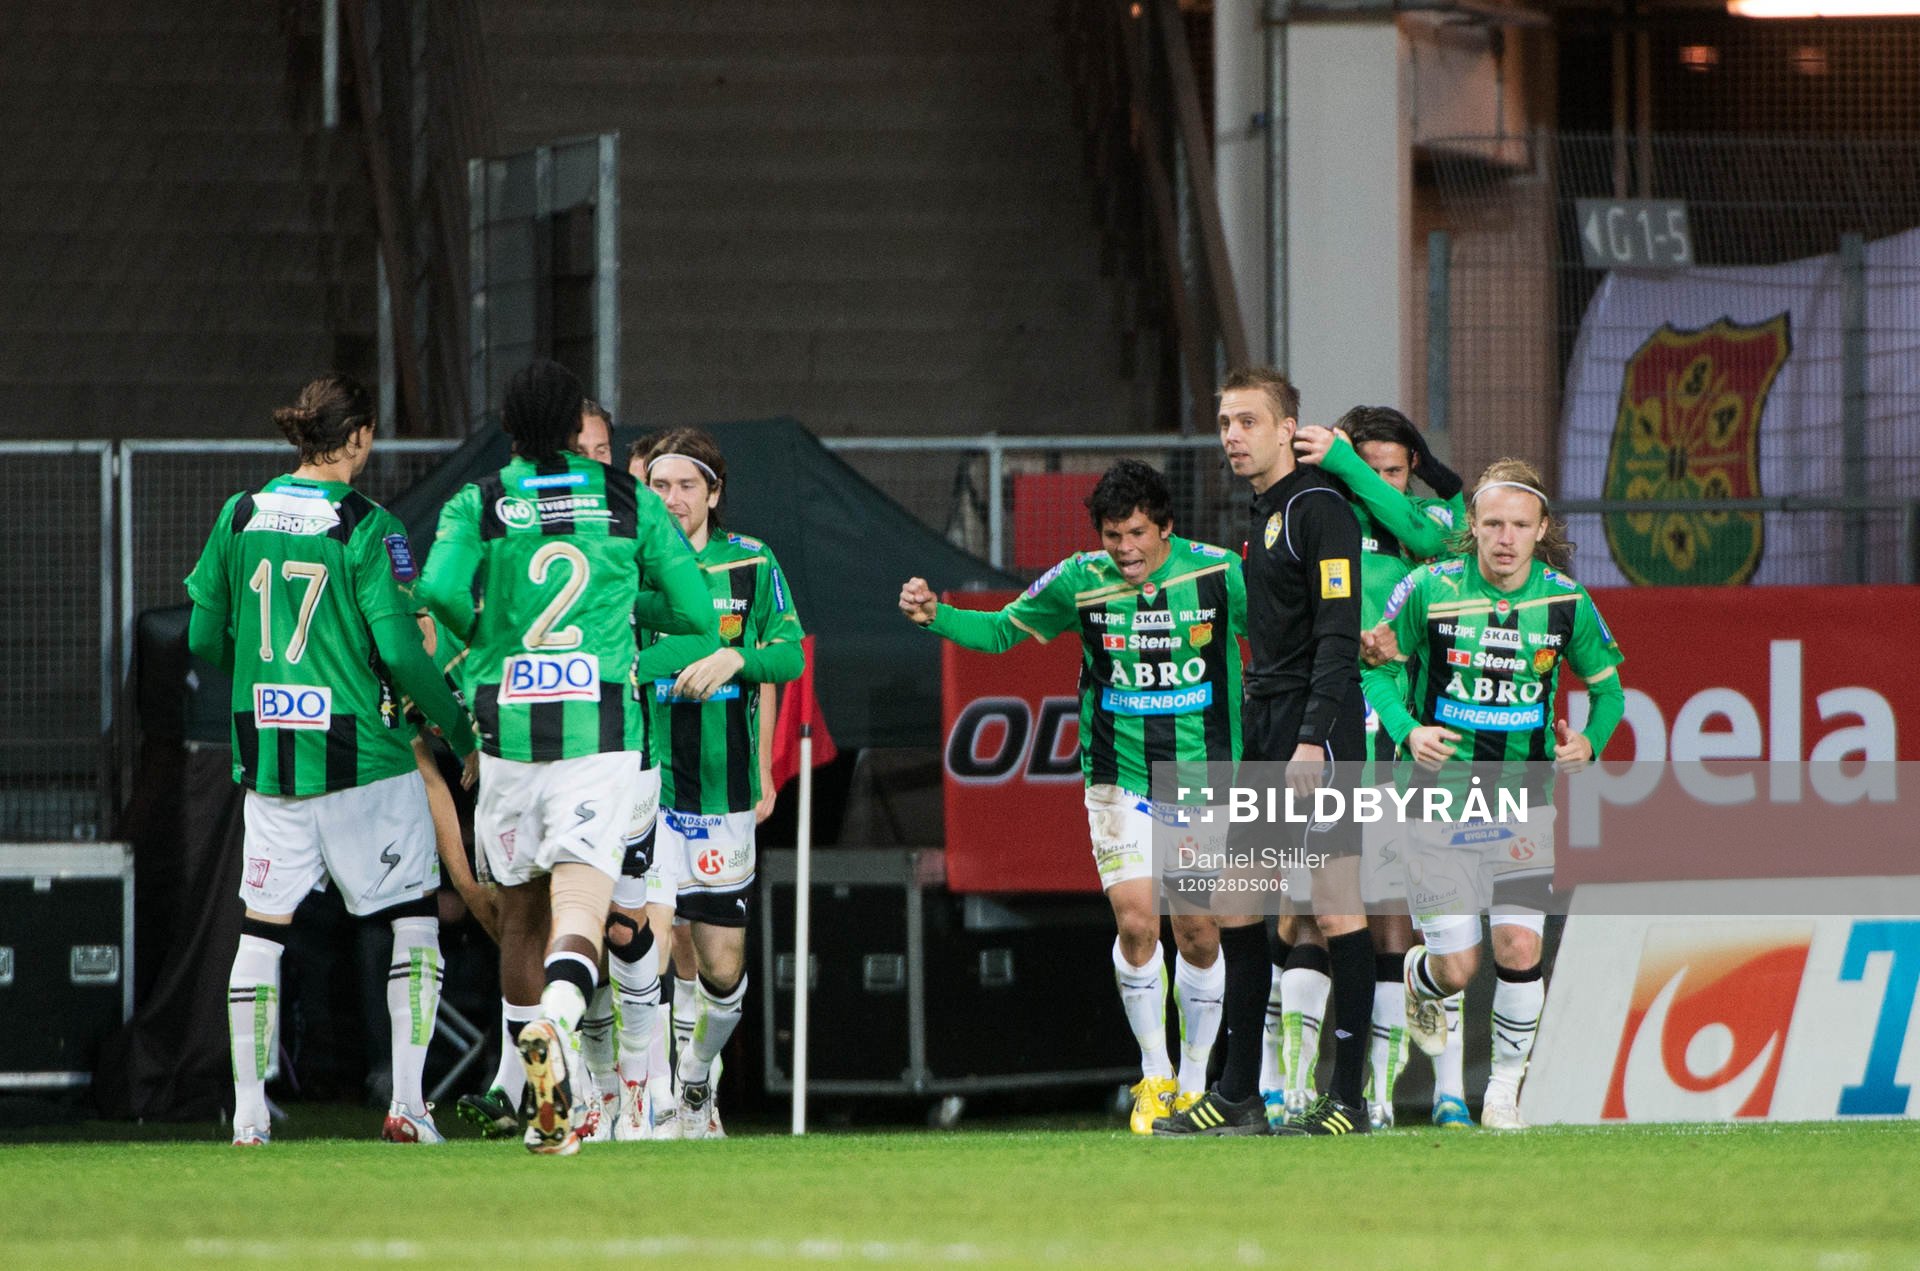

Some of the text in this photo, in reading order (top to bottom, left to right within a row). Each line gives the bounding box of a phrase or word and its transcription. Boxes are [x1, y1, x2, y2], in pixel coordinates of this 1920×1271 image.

[1607, 207, 1689, 262] G 1-5
[250, 512, 328, 534] ARROW
[522, 541, 590, 651] 2
[249, 557, 329, 665] 17
[1135, 614, 1171, 624] SKAB
[1129, 635, 1182, 650] Stena
[1484, 630, 1520, 643] SKAB
[512, 658, 592, 690] BDO
[1110, 657, 1206, 688] ÅBRO
[1473, 652, 1527, 671] Stena
[1110, 689, 1206, 710] EHRENBORG
[1445, 672, 1543, 704] ÅBRO
[262, 688, 325, 718] BDO
[1442, 703, 1539, 725] EHRENBORG
